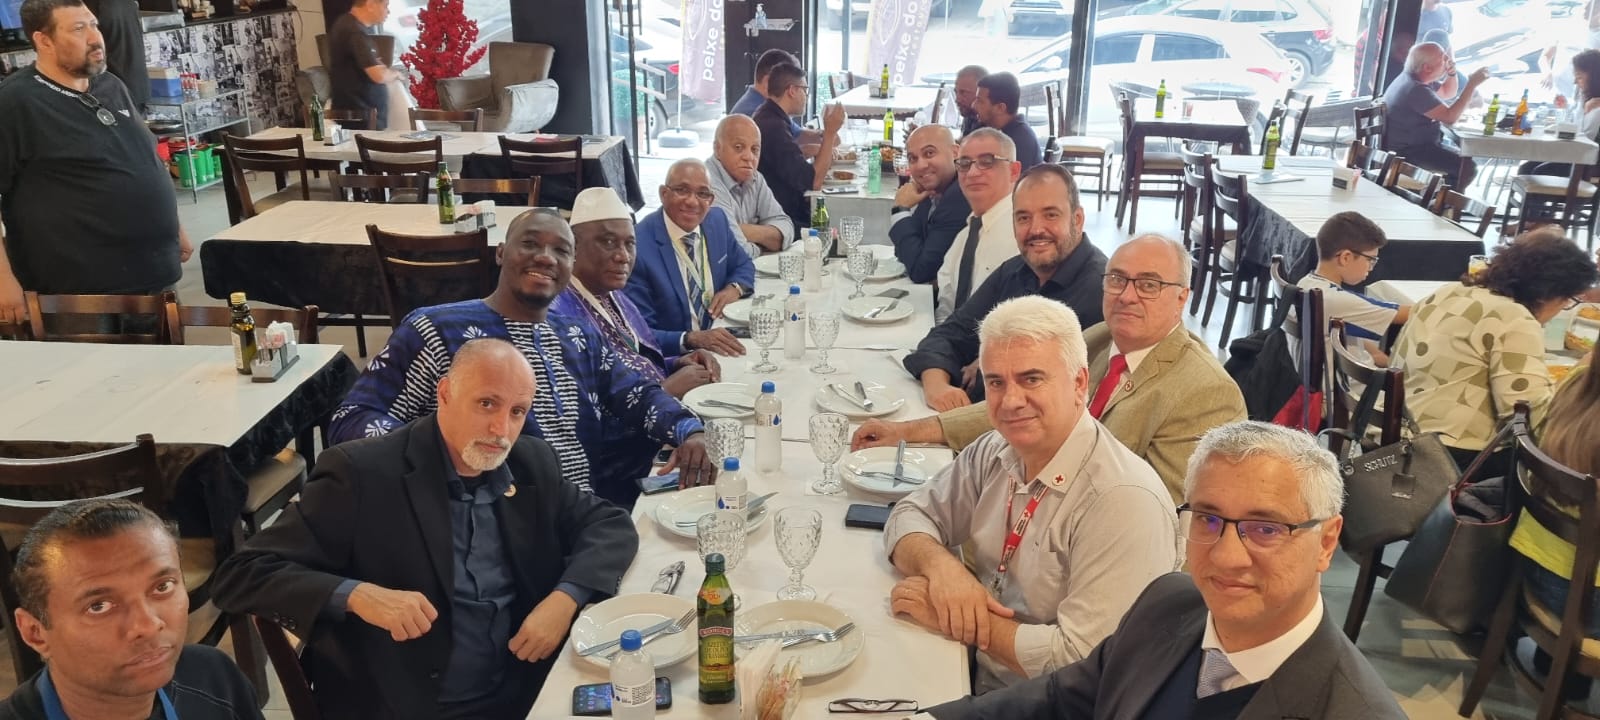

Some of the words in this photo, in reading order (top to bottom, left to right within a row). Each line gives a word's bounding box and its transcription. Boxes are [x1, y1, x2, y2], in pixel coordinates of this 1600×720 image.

[702, 27, 719, 82] peixe
[893, 32, 912, 86] peixe
[903, 1, 918, 26] do
